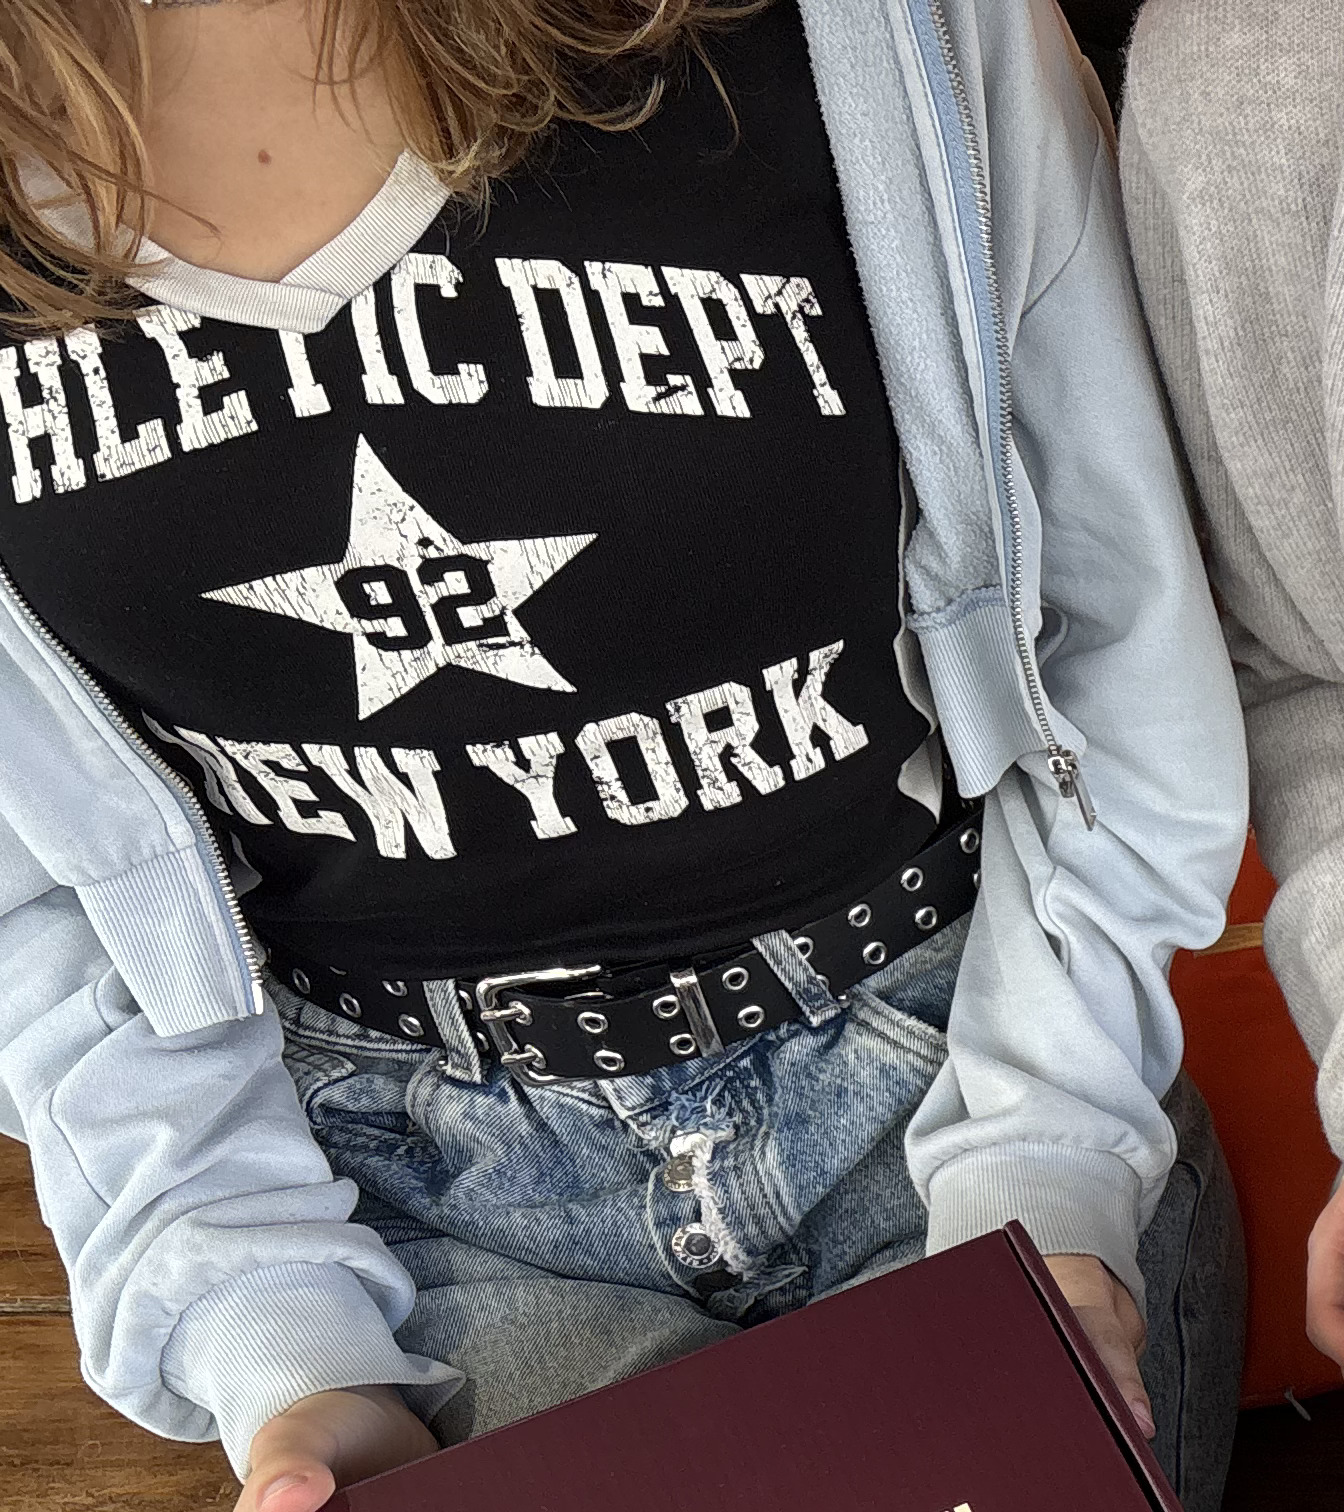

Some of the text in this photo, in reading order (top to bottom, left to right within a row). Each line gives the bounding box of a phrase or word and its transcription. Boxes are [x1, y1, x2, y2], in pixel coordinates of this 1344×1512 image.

[494, 256, 847, 419] DEPT
[334, 552, 511, 652] 92
[465, 639, 869, 840] YORK
